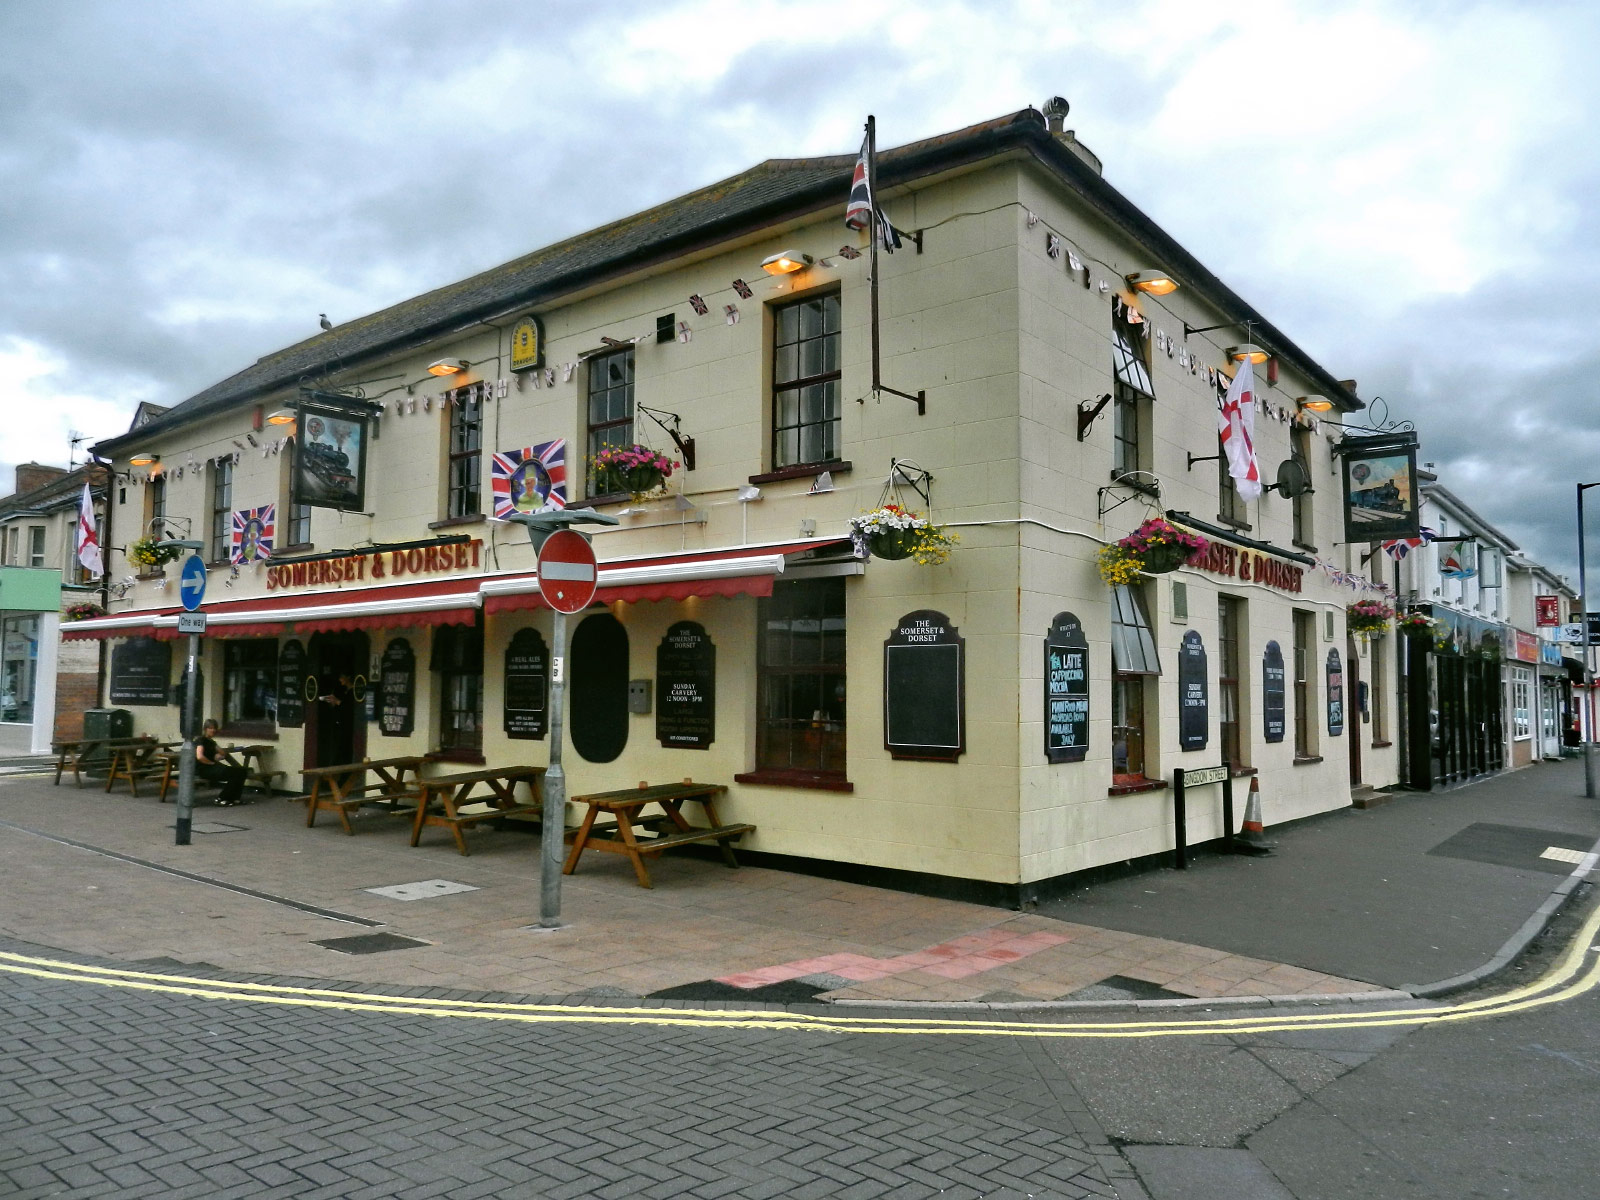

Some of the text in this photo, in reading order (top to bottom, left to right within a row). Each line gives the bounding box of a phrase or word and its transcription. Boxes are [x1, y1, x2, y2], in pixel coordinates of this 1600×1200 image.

[266, 538, 483, 590] SOMERSET & DORSET
[1240, 550, 1252, 580] &
[1253, 554, 1304, 593] DORSET
[180, 617, 204, 629] One way
[915, 619, 930, 627] THE
[900, 626, 945, 635] SOMERSET &
[908, 634, 937, 642] DORSET
[1063, 653, 1082, 669] LATTE
[1050, 680, 1069, 693] MOCHA
[671, 689, 698, 697] CARVERY
[1209, 767, 1226, 780] STREET
